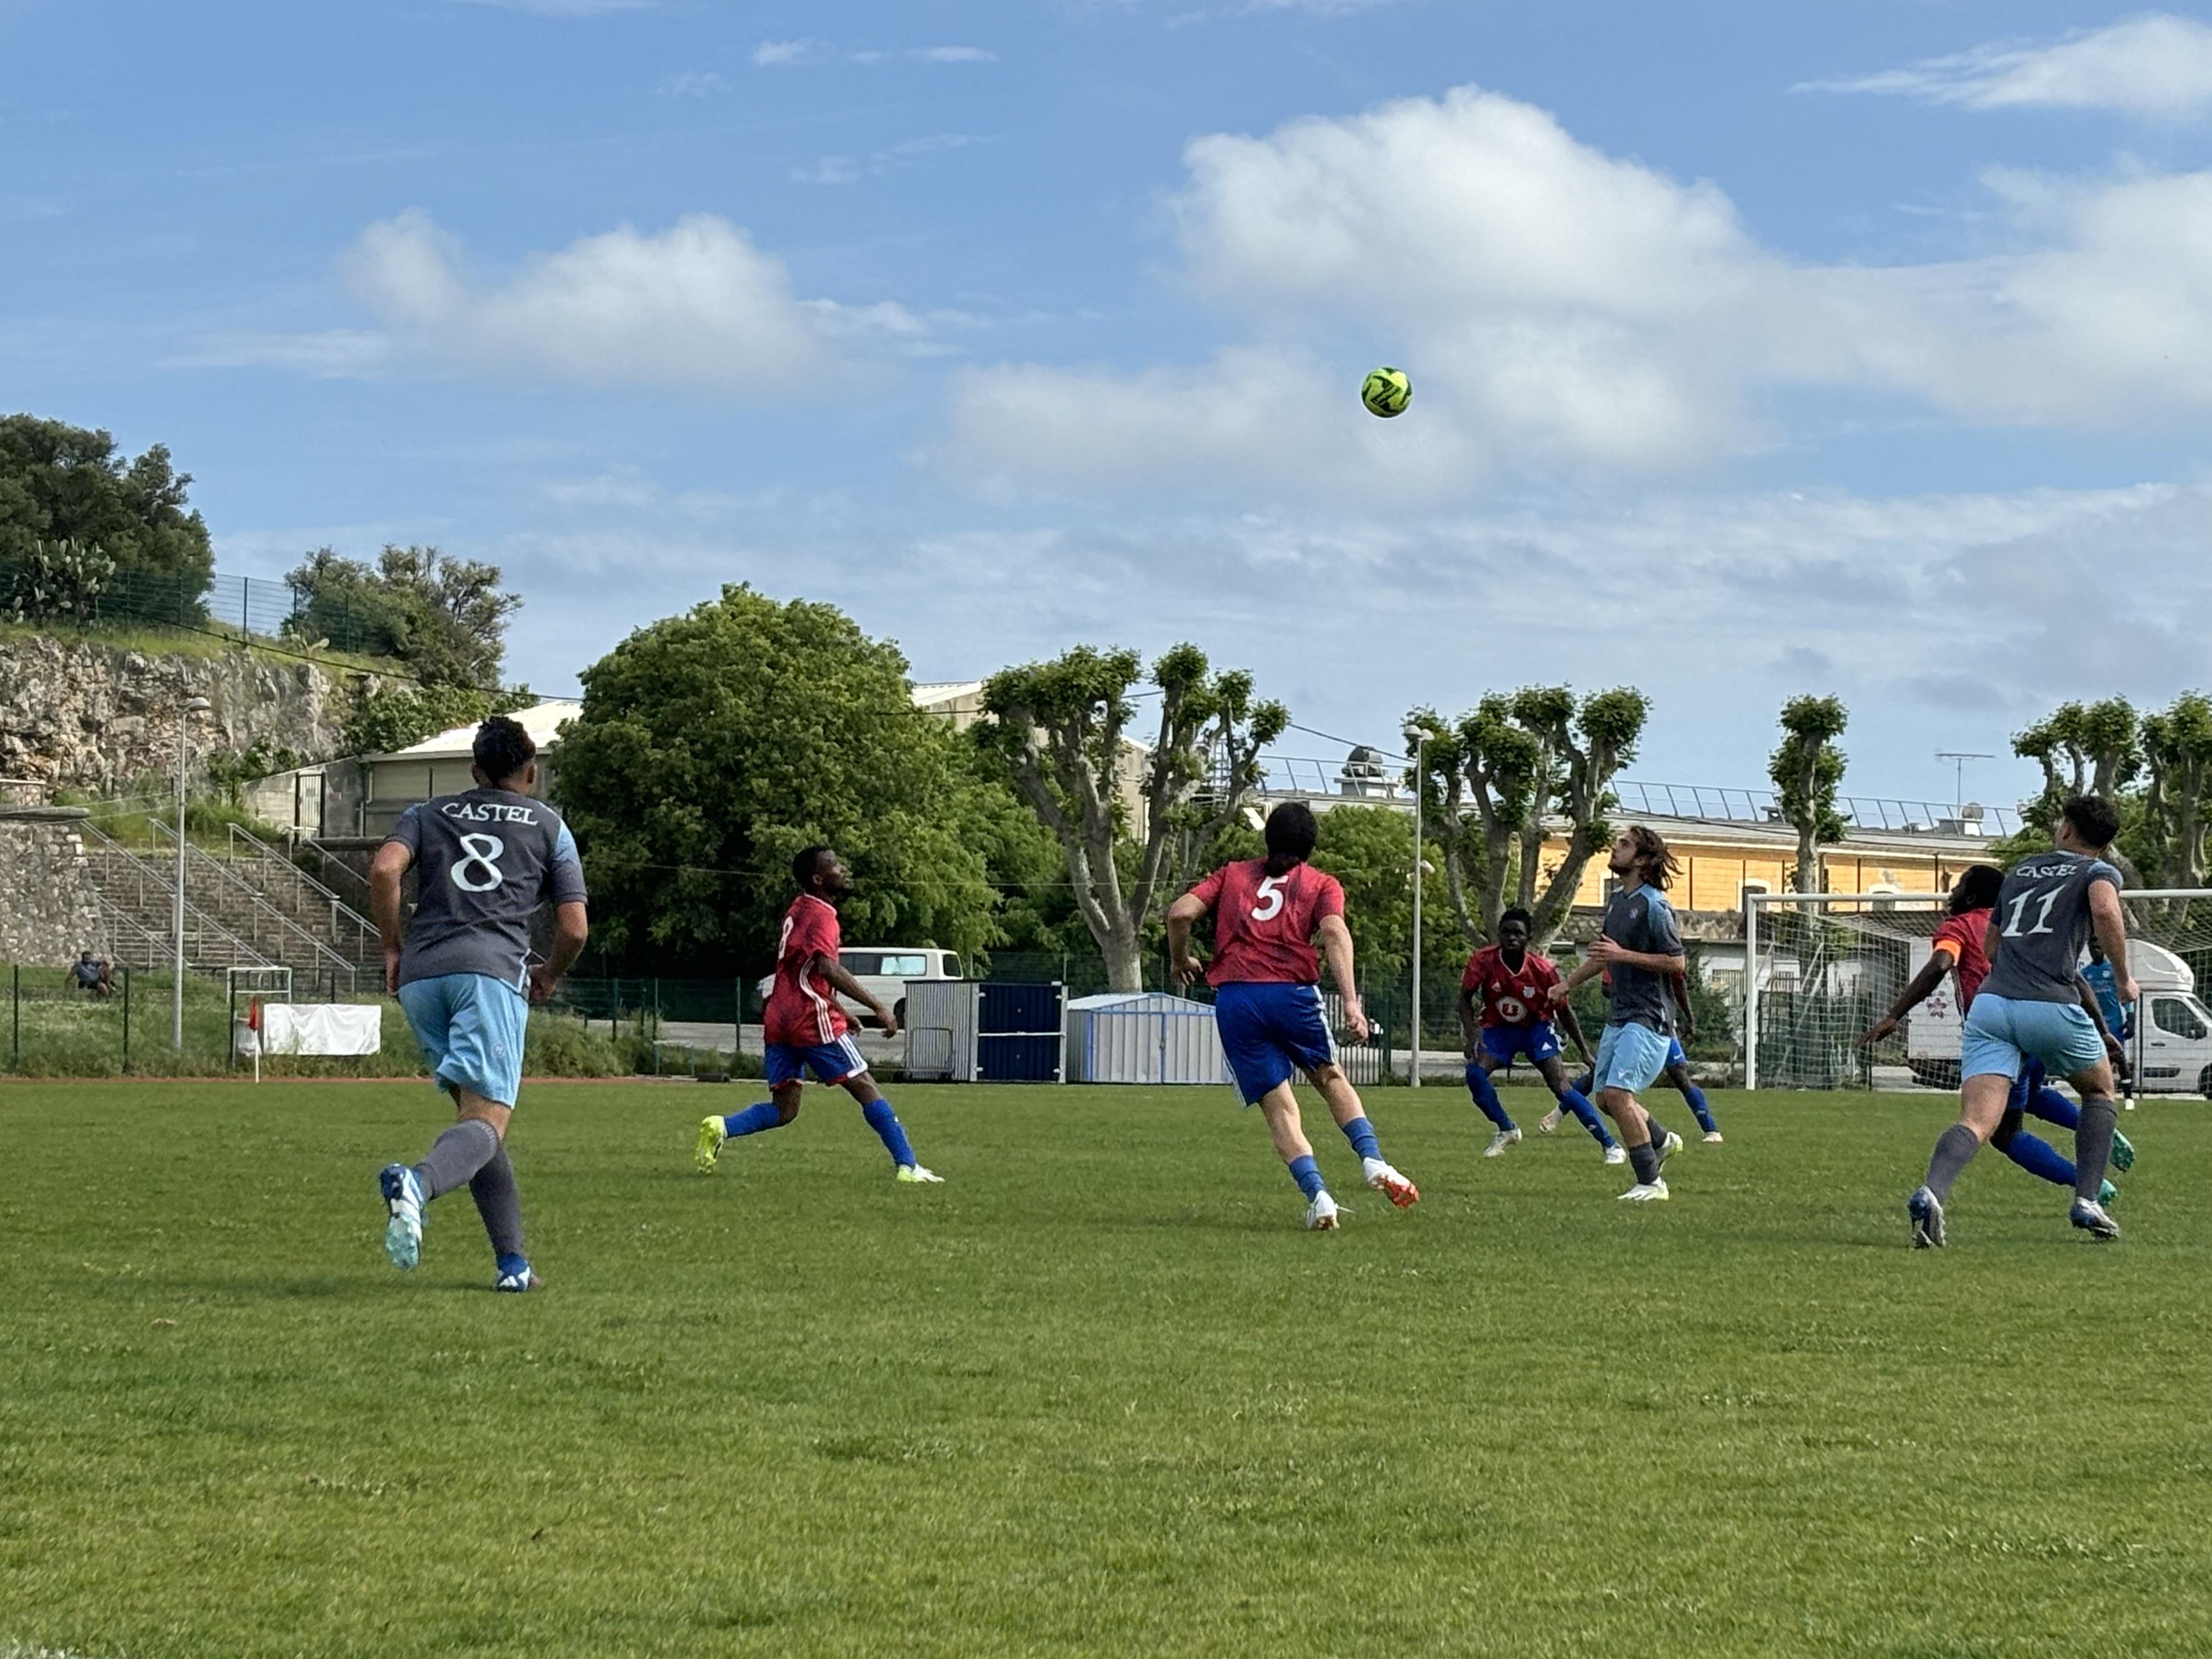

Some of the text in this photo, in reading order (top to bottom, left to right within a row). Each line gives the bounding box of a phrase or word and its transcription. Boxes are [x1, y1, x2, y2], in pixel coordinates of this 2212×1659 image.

[441, 802, 539, 826] CASTEL
[450, 832, 504, 892] 8
[1251, 874, 1289, 921] 5
[2001, 883, 2067, 938] 11
